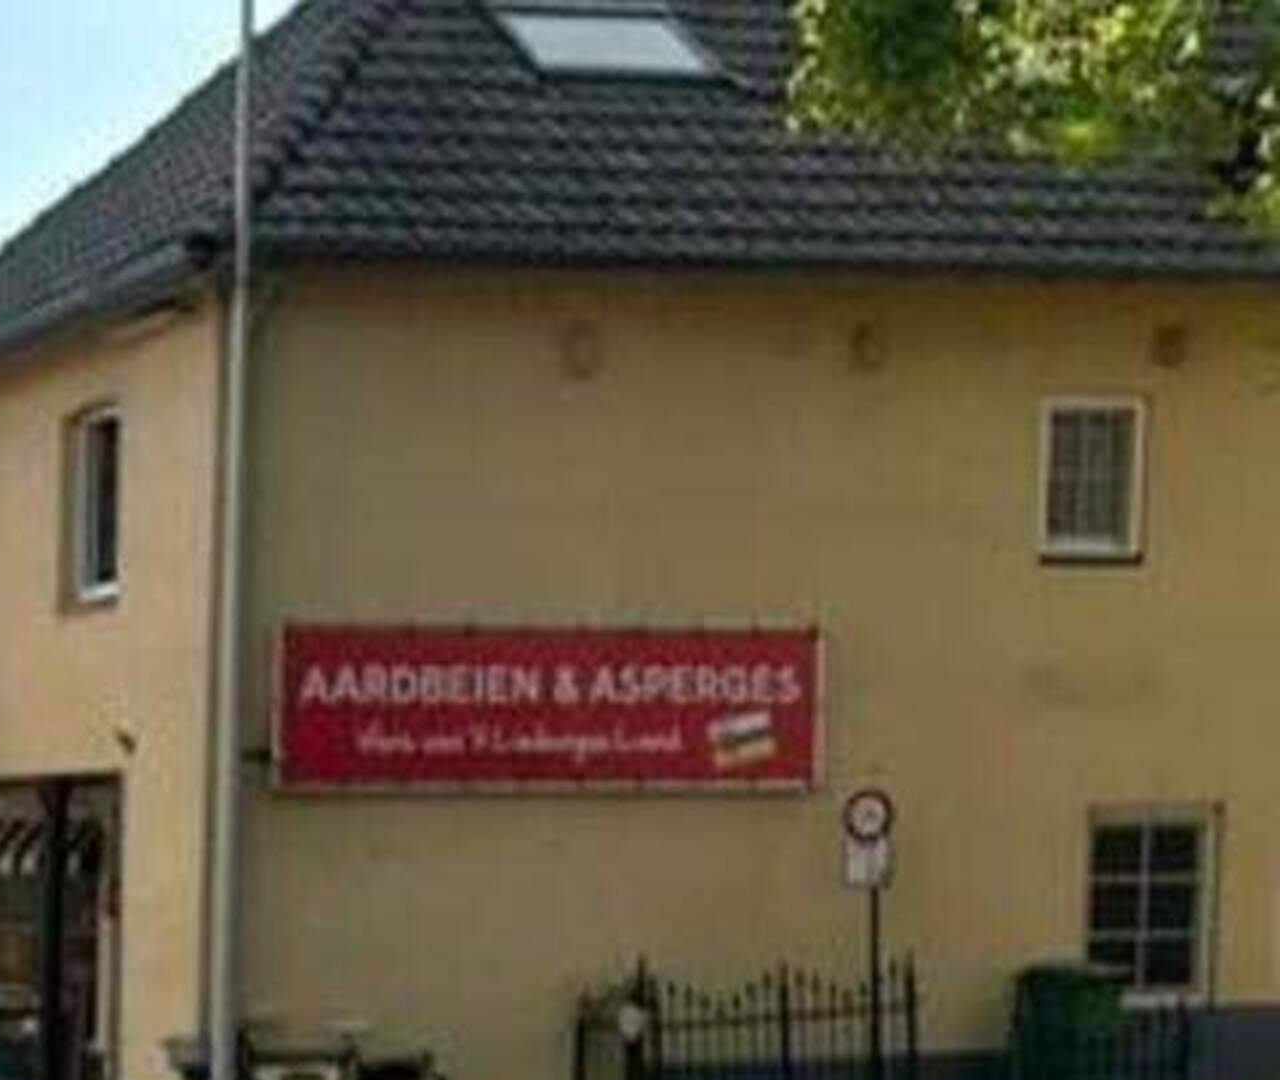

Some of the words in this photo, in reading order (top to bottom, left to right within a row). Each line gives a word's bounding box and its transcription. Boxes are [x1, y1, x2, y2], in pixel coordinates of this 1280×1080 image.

[300, 665, 541, 702] AARDBEIEN
[552, 666, 580, 702] &
[591, 665, 802, 703] ASPERGES
